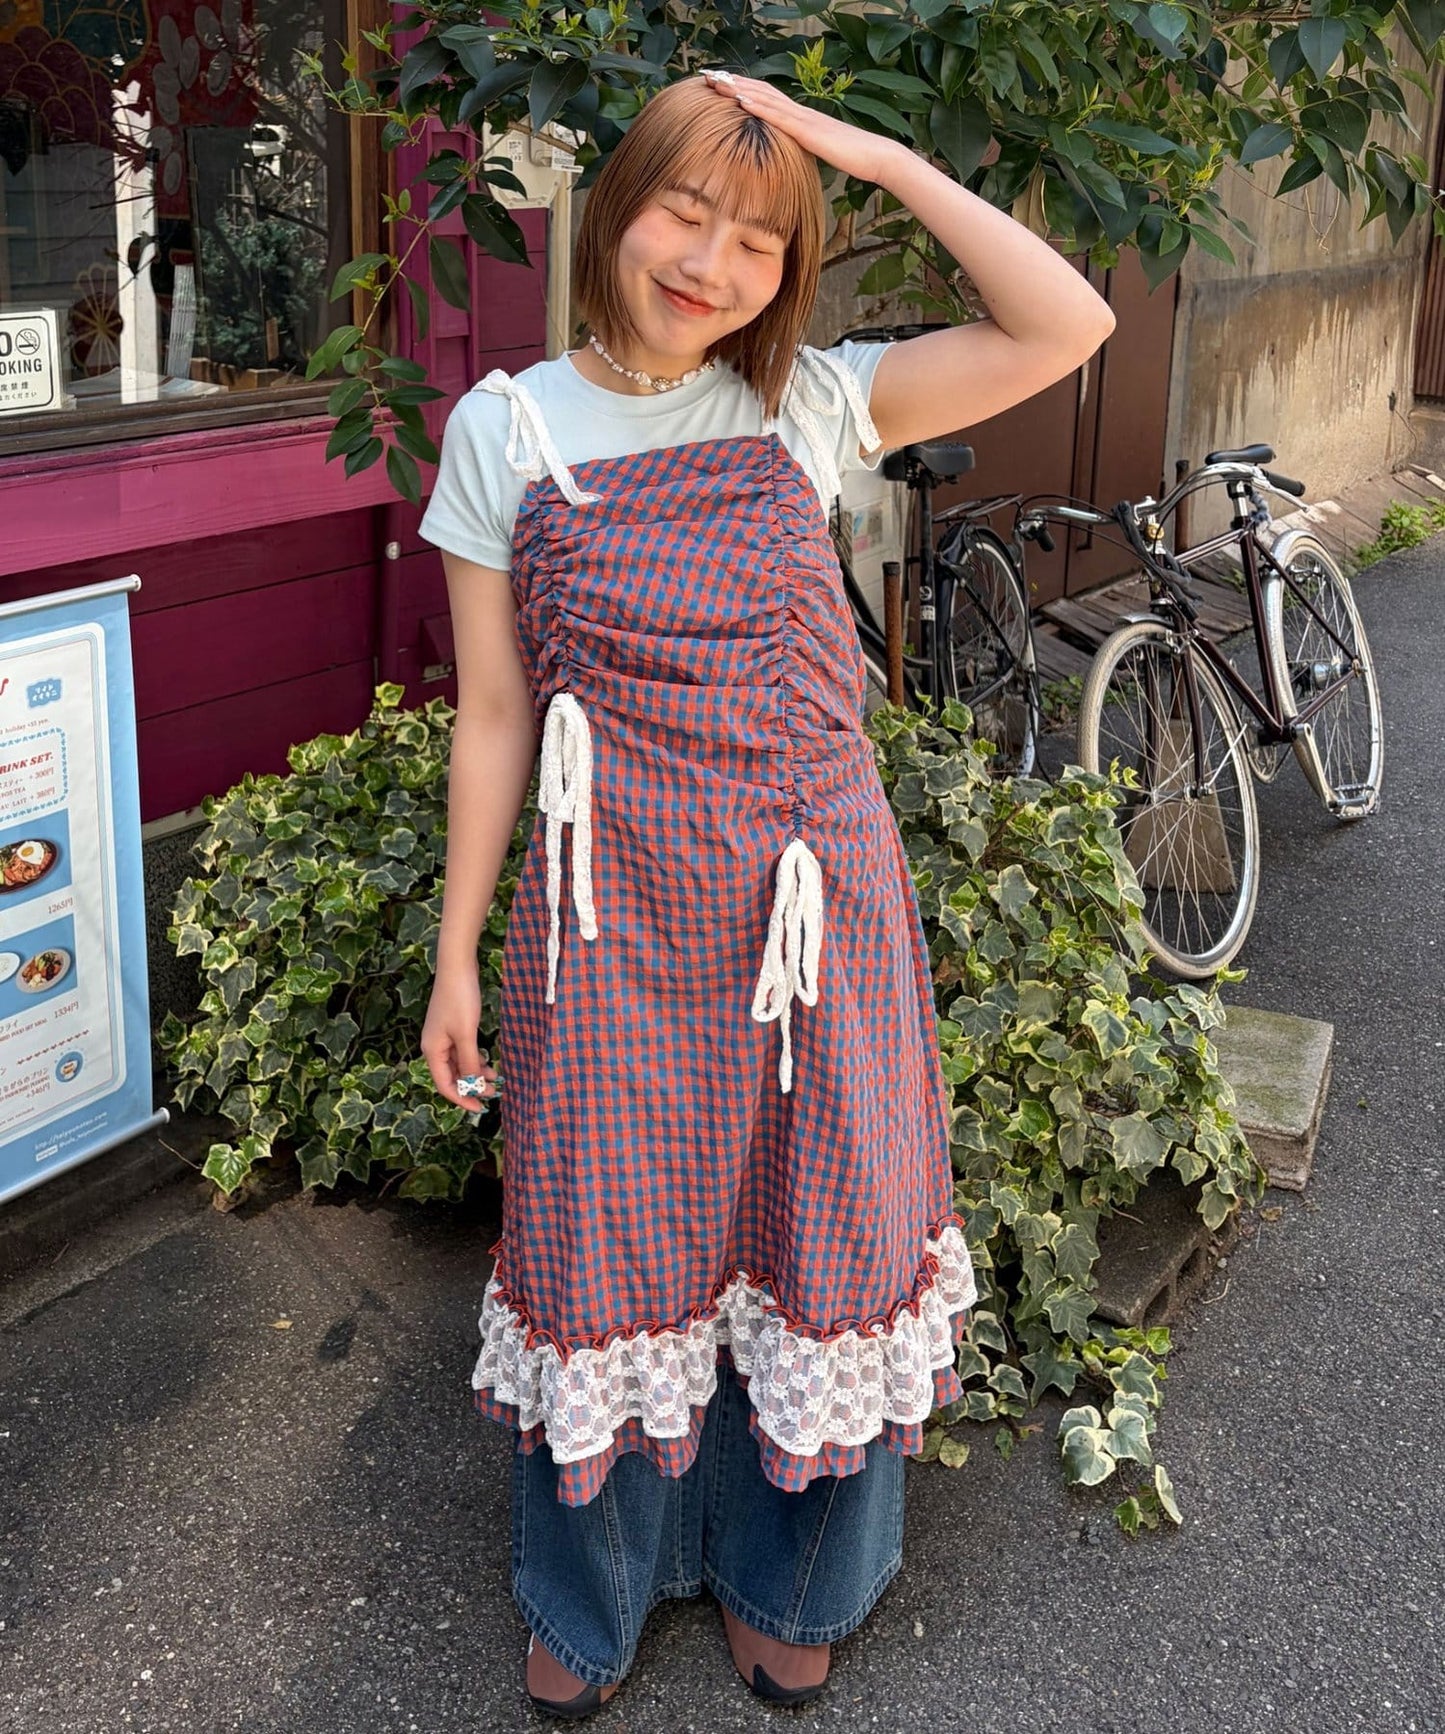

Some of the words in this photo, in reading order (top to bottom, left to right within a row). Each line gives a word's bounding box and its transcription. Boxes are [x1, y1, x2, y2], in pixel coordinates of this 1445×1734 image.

[0, 358, 42, 376] OKING
[29, 751, 53, 767] SET.
[48, 897, 74, 915] 1265円
